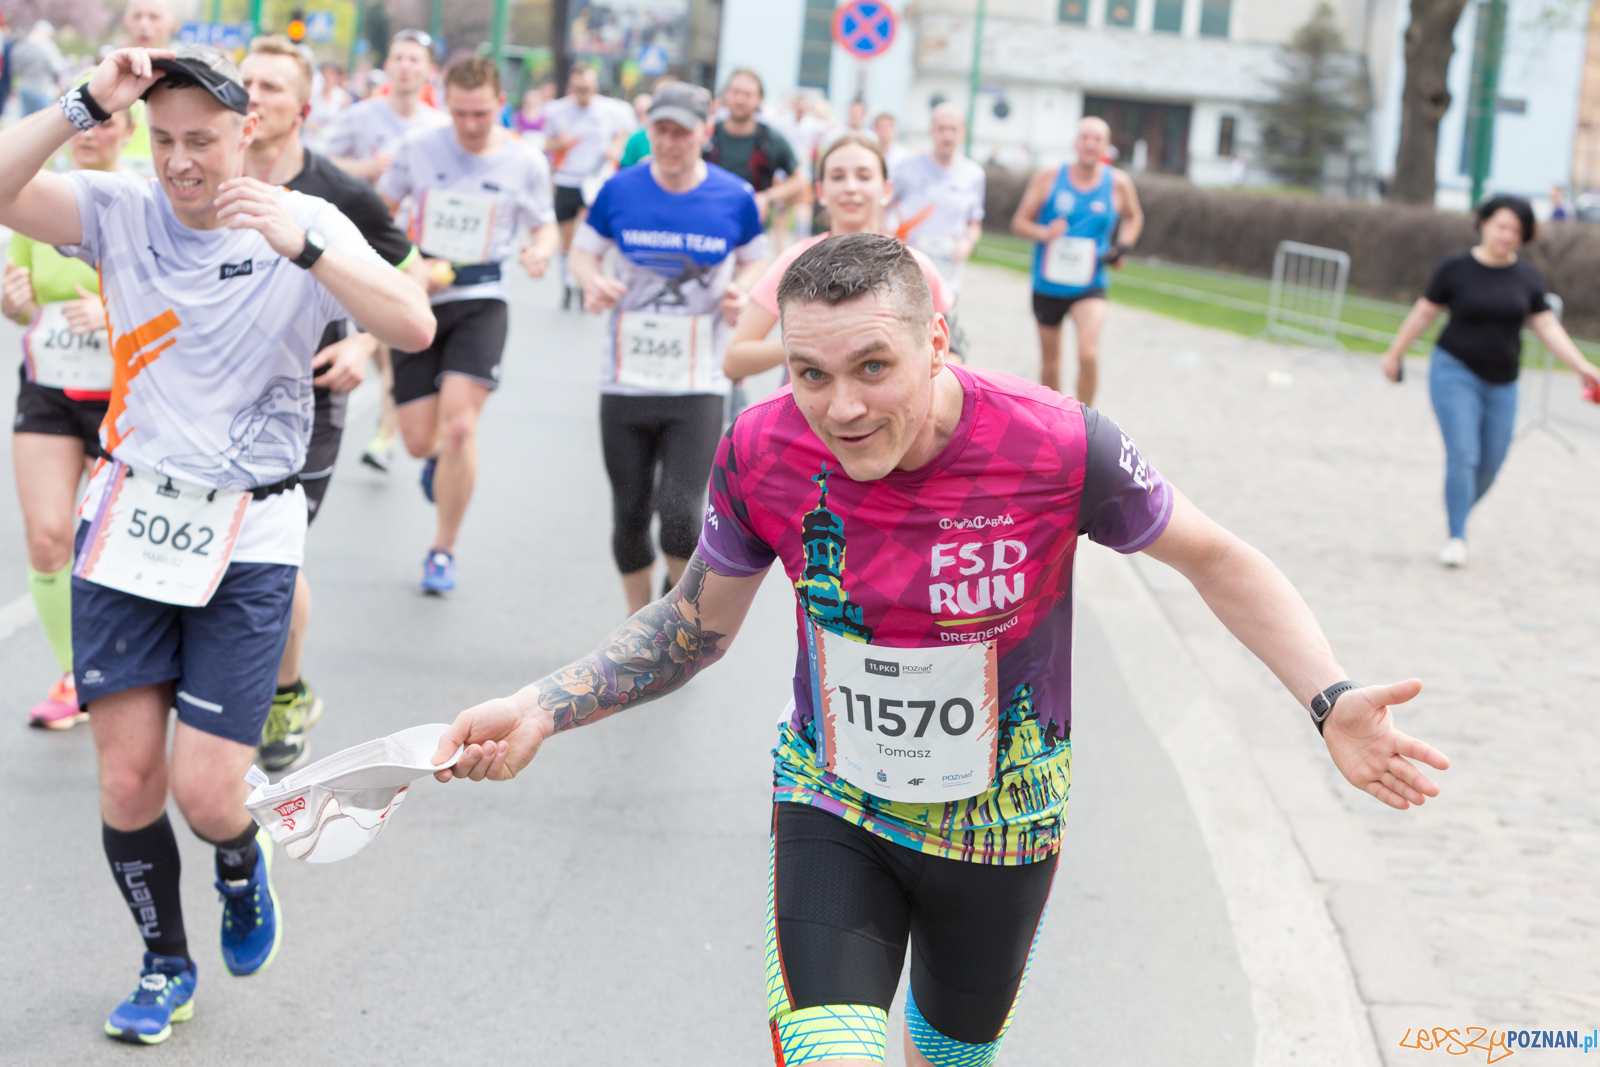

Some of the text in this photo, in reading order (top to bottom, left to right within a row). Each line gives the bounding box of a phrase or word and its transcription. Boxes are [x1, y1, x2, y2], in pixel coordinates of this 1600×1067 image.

[686, 233, 727, 254] TEAM
[631, 335, 684, 360] 2365
[127, 508, 215, 557] 5062
[930, 539, 1028, 578] FSD
[929, 571, 1025, 615] RUN
[940, 615, 1019, 643] DREZDENKO
[838, 685, 975, 738] 11570
[876, 743, 932, 759] Tomasz
